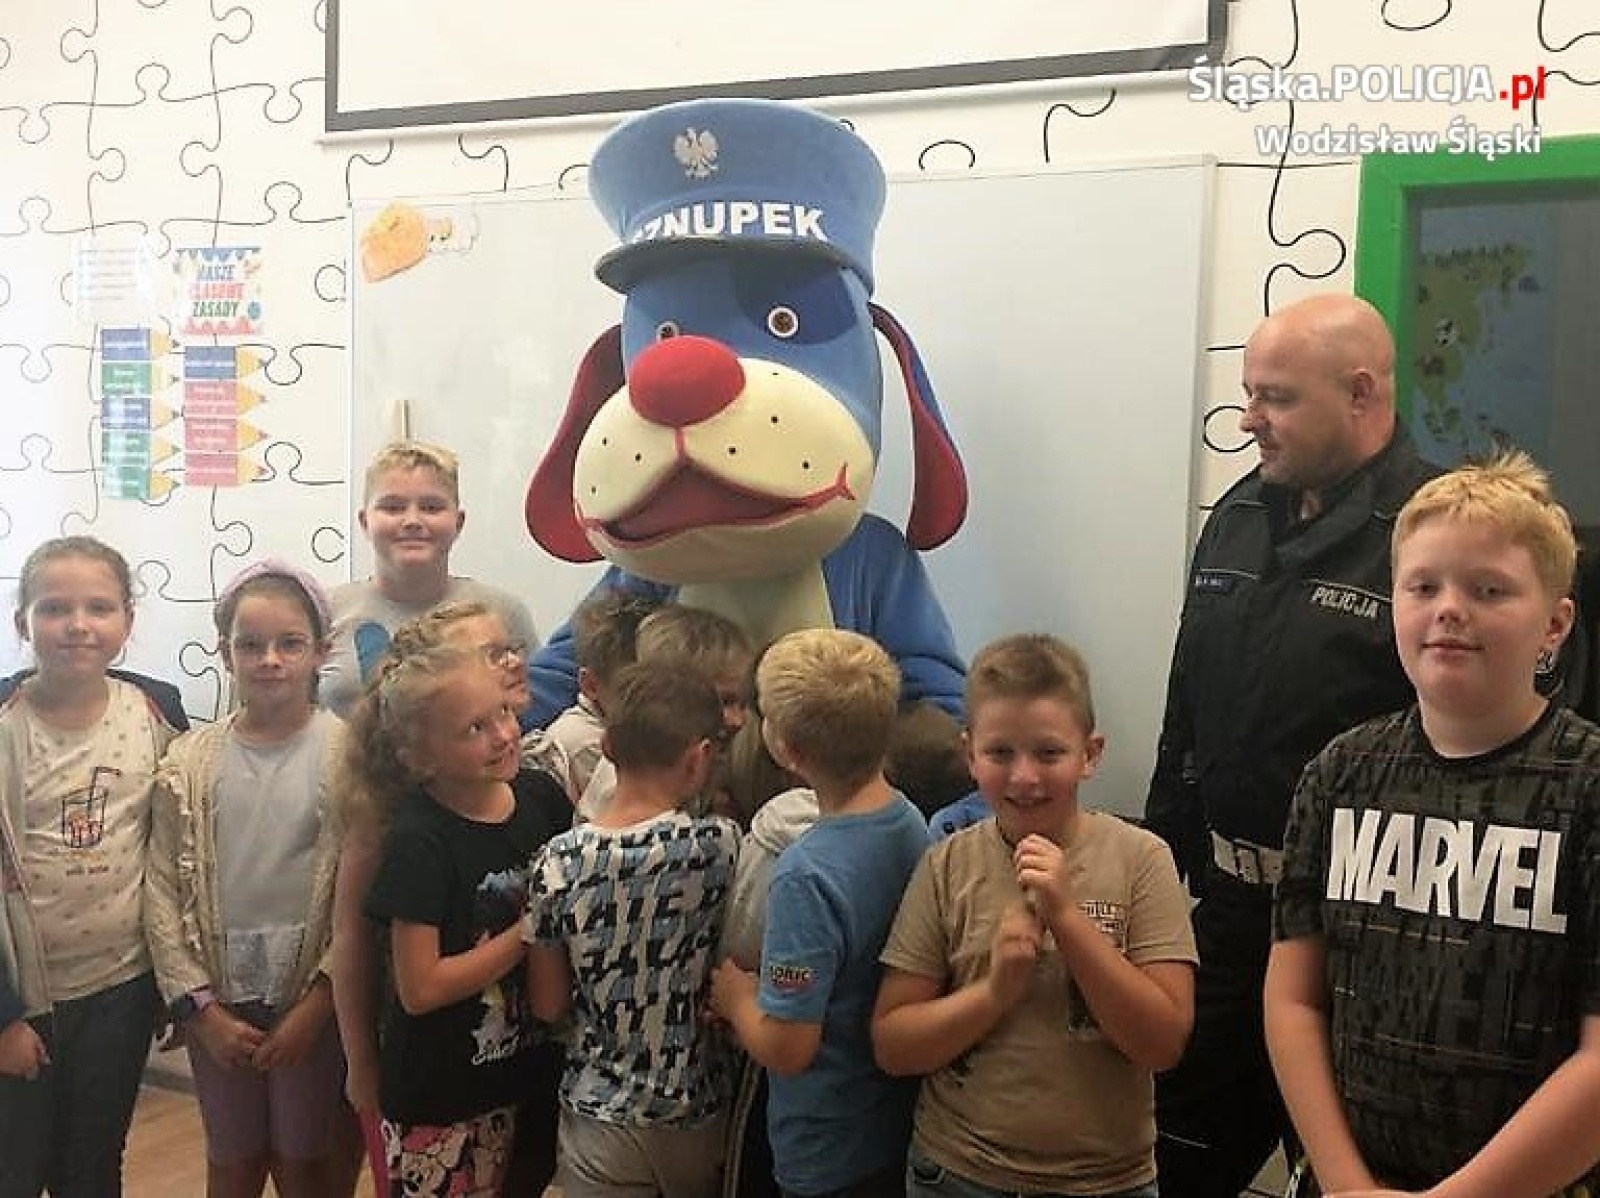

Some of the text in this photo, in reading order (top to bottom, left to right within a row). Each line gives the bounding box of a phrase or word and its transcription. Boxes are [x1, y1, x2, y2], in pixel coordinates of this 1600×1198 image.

[192, 301, 239, 317] ZASADY
[1310, 586, 1380, 620] POLICJA
[1326, 807, 1568, 935] MARVEL
